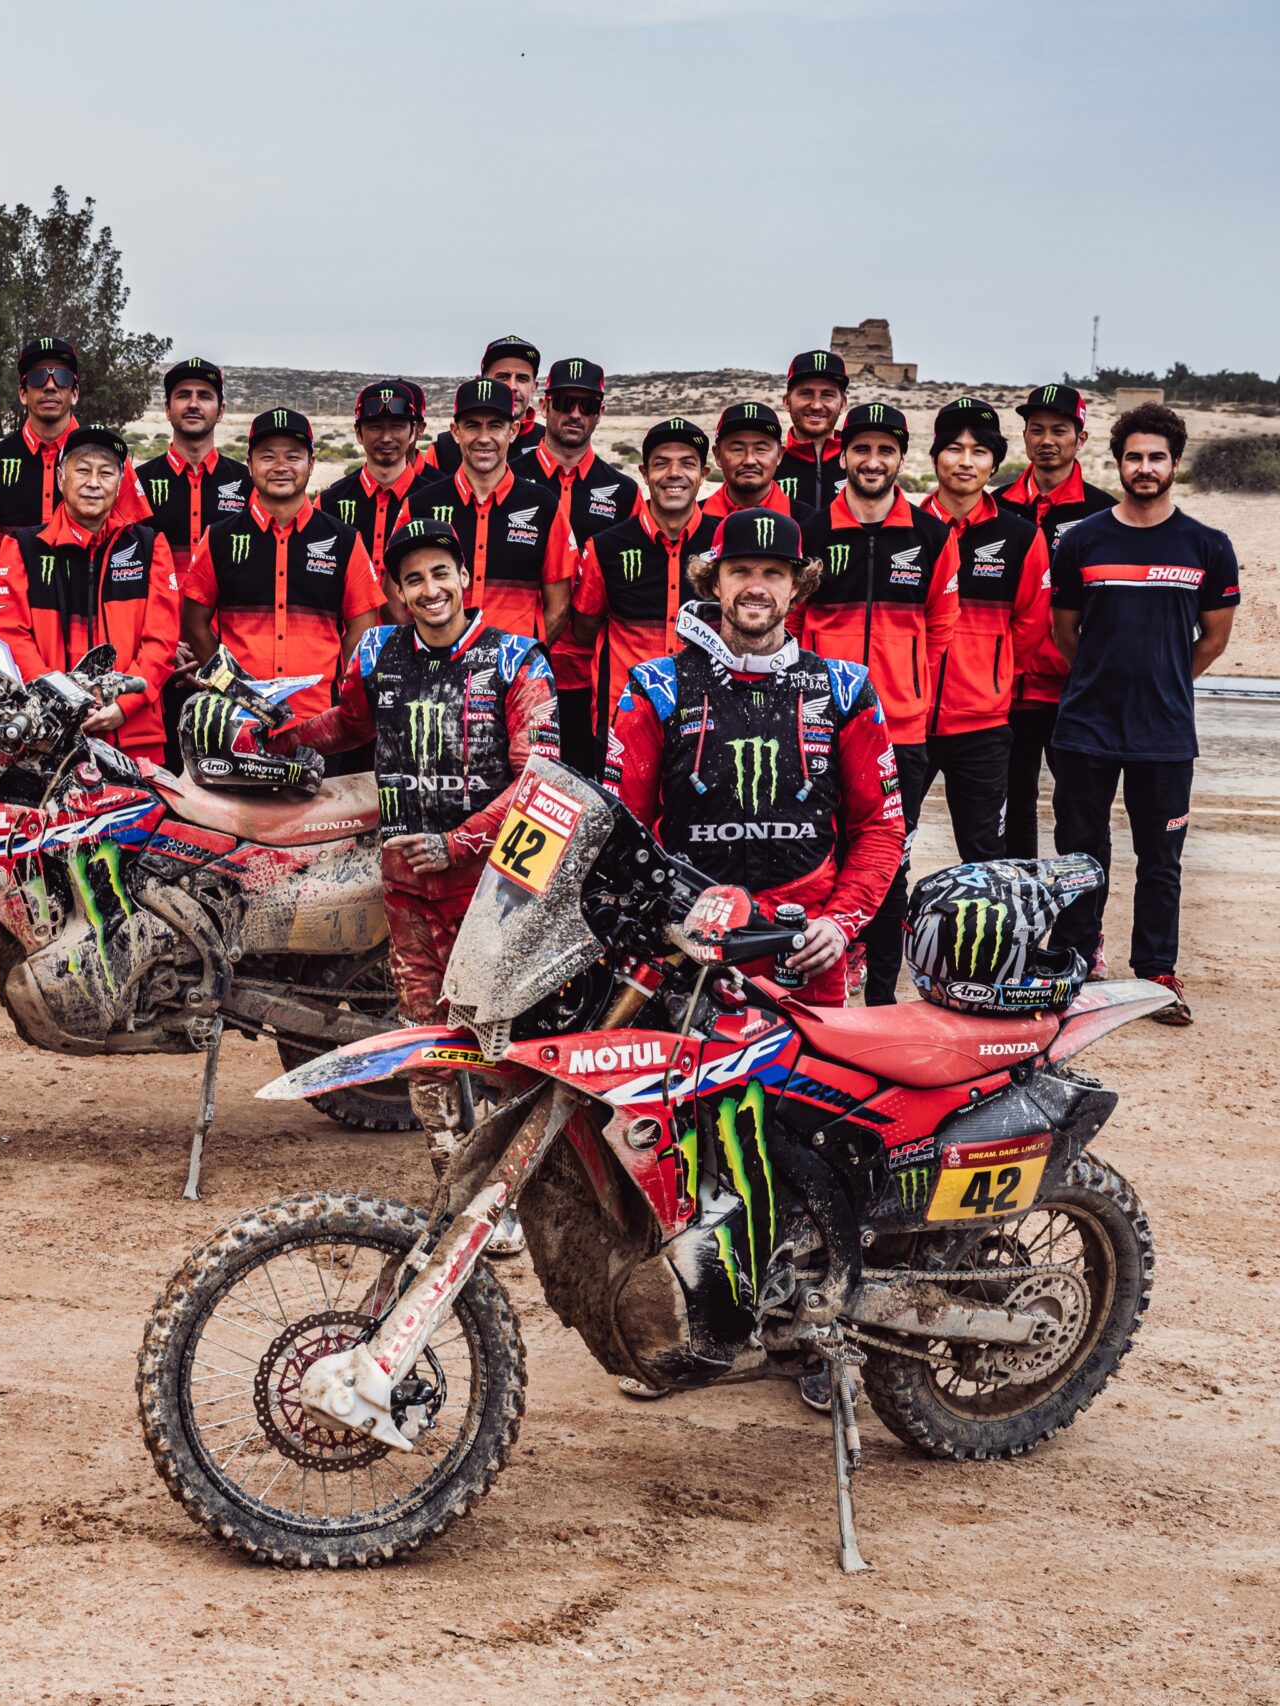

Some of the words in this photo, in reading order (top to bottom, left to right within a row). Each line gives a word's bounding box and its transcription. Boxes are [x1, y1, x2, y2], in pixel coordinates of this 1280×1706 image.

[218, 493, 246, 501] HONDA
[590, 496, 617, 507] HONDA
[507, 522, 538, 532] HONDA
[110, 560, 142, 568] HONDA
[307, 552, 337, 562] HONDA
[891, 563, 922, 572] HONDA
[1146, 567, 1204, 585] SHOWA
[690, 625, 734, 664] AMEXIO
[790, 679, 807, 689] AIR
[809, 681, 830, 691] BAG
[239, 762, 285, 775] MONSTER
[532, 792, 574, 826] MOTUL
[303, 819, 364, 833] HONDA
[689, 822, 818, 841] HONDA
[500, 819, 547, 879] 42
[1005, 988, 1053, 999] MONSTER
[740, 1020, 762, 1034] 450
[978, 1041, 1040, 1055] HONDA
[568, 1041, 667, 1075] MOTUL
[601, 1029, 795, 1106] CRF
[889, 1137, 936, 1161] HRC
[968, 1150, 998, 1160] DREAM.
[998, 1147, 1020, 1157] DARE.
[959, 1166, 1023, 1215] 42
